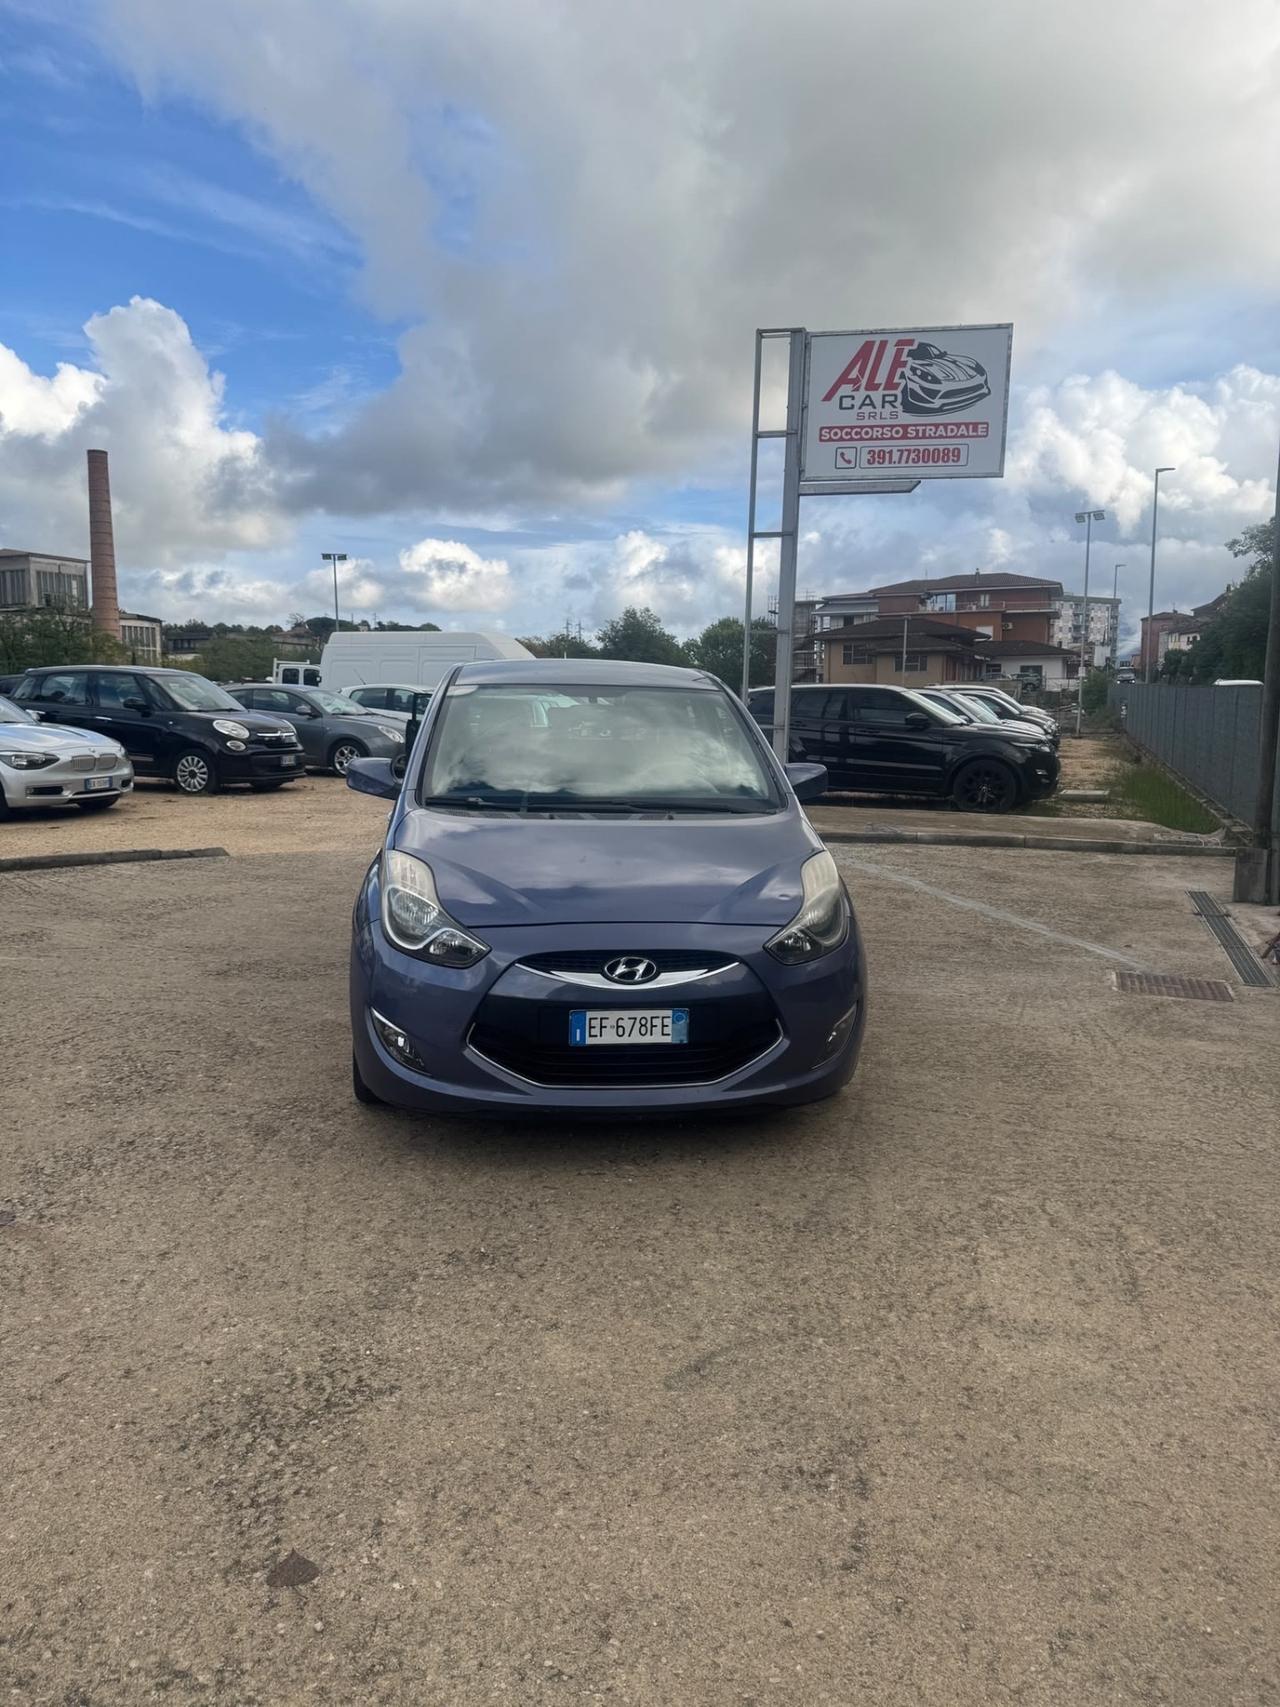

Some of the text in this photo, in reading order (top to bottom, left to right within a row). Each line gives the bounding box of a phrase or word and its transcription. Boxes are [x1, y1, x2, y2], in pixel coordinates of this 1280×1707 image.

[821, 338, 915, 402] ALE
[838, 393, 899, 411] CAR
[856, 410, 899, 421] SRLS
[821, 424, 988, 440] SOCCORSO STRADALE
[866, 447, 962, 466] 391.7730089
[588, 1017, 609, 1038] EF
[615, 1016, 671, 1037] 678FE
